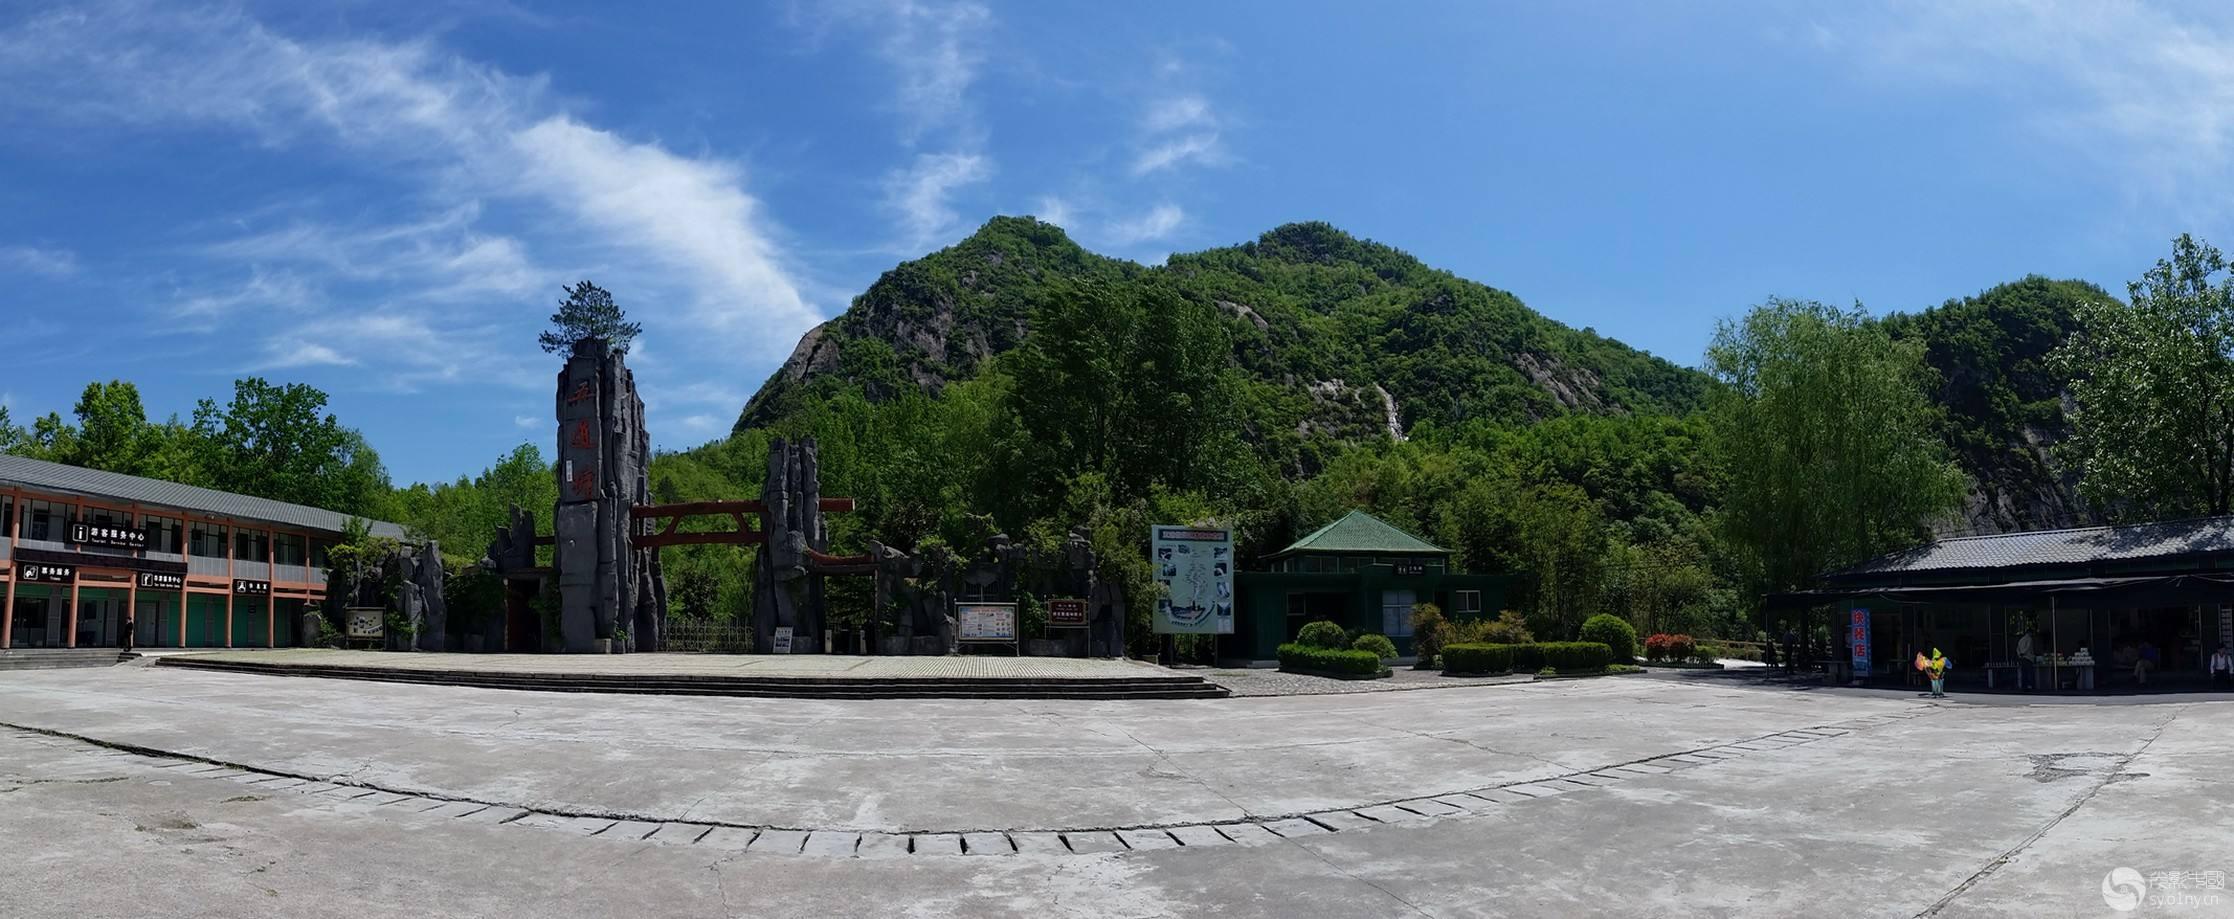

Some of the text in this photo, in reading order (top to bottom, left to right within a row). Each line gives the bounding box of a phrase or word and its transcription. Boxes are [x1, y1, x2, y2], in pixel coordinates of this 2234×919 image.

[90, 527, 145, 541] 游客服务中心
